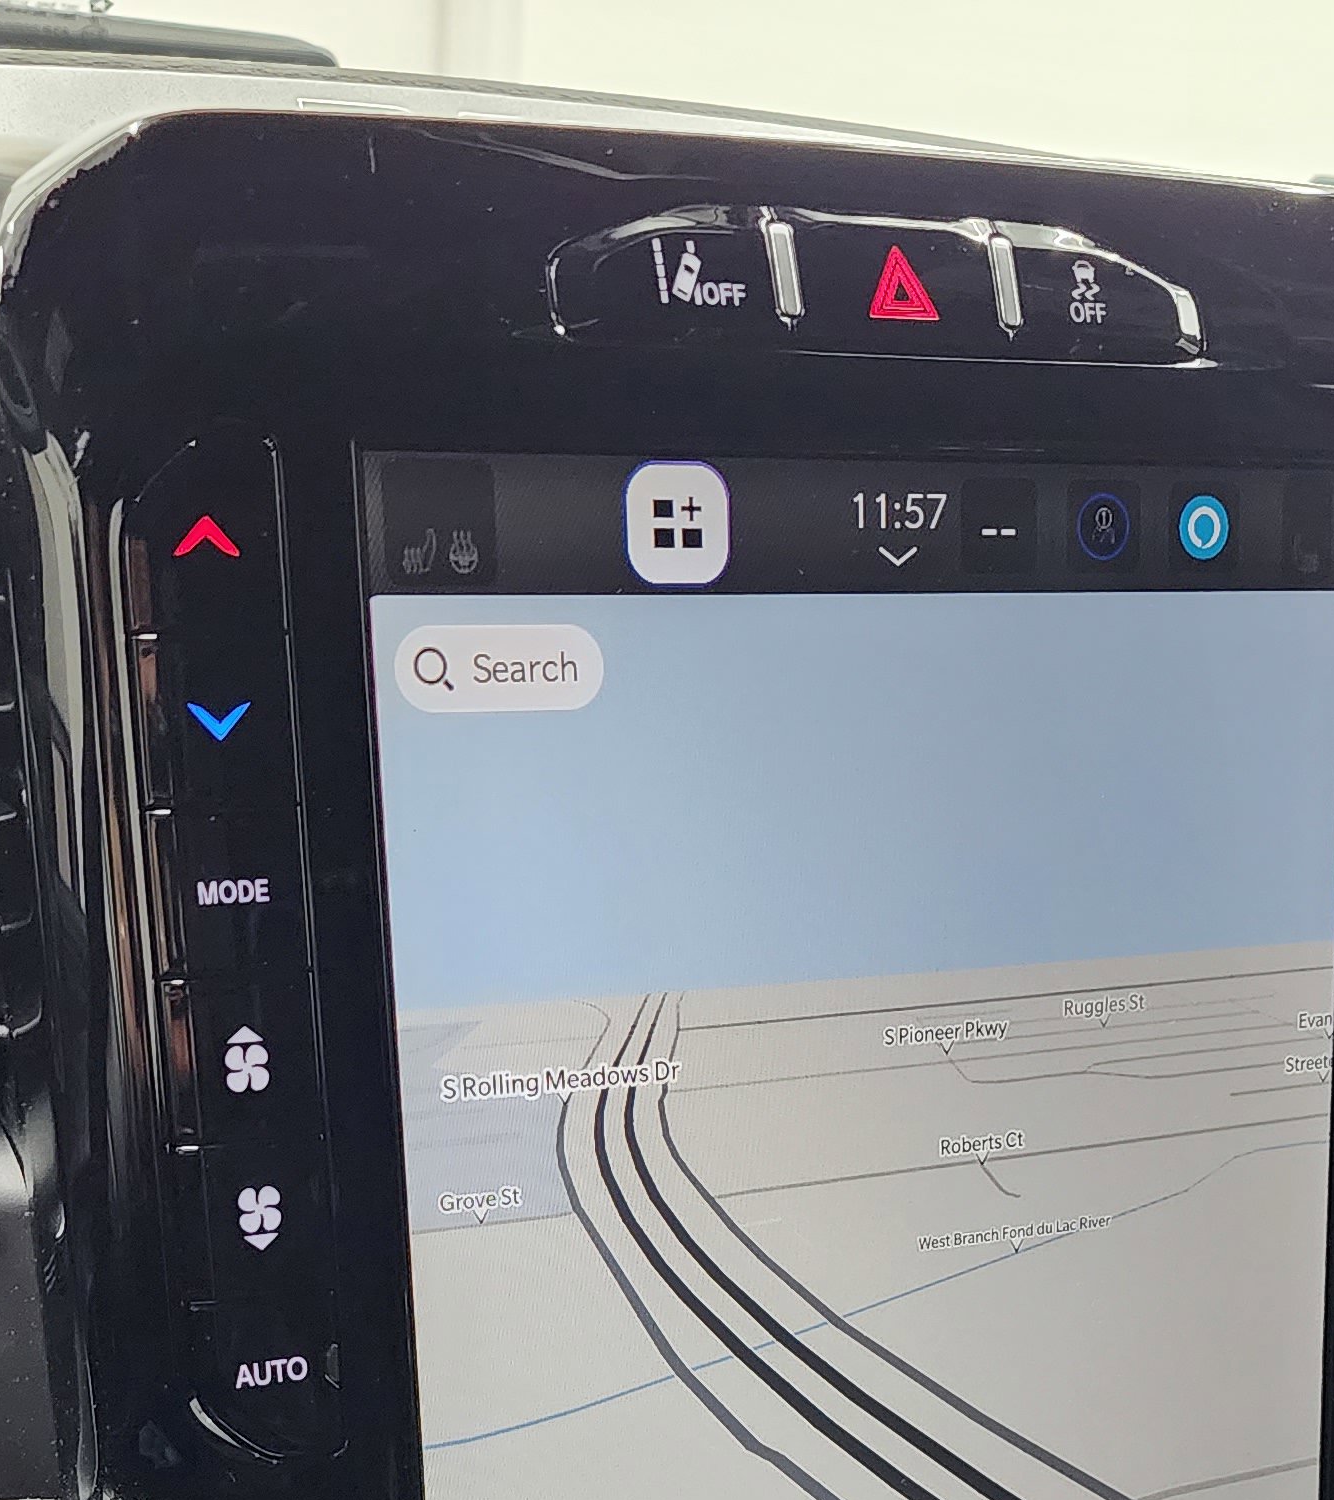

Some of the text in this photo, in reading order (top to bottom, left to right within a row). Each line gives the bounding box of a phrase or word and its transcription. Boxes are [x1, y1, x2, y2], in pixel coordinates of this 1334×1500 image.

[703, 284, 746, 306] OFF
[1069, 302, 1106, 324] OFF
[851, 493, 947, 531] 11:57
[473, 653, 578, 685] Search
[197, 879, 270, 906] MODE
[1064, 994, 1145, 1018] Ruggles St
[884, 1020, 1008, 1045] S Pioneer Pkwy
[1299, 1012, 1332, 1029] Evan
[1285, 1055, 1333, 1073] Street
[444, 1061, 680, 1099] S Rolling Meadows Dr
[940, 1131, 1023, 1155] Roberts Ct
[440, 1187, 519, 1212] Grove St
[919, 1215, 1111, 1250] West Branch Fond du Lac River
[236, 1356, 308, 1388] AUTO
